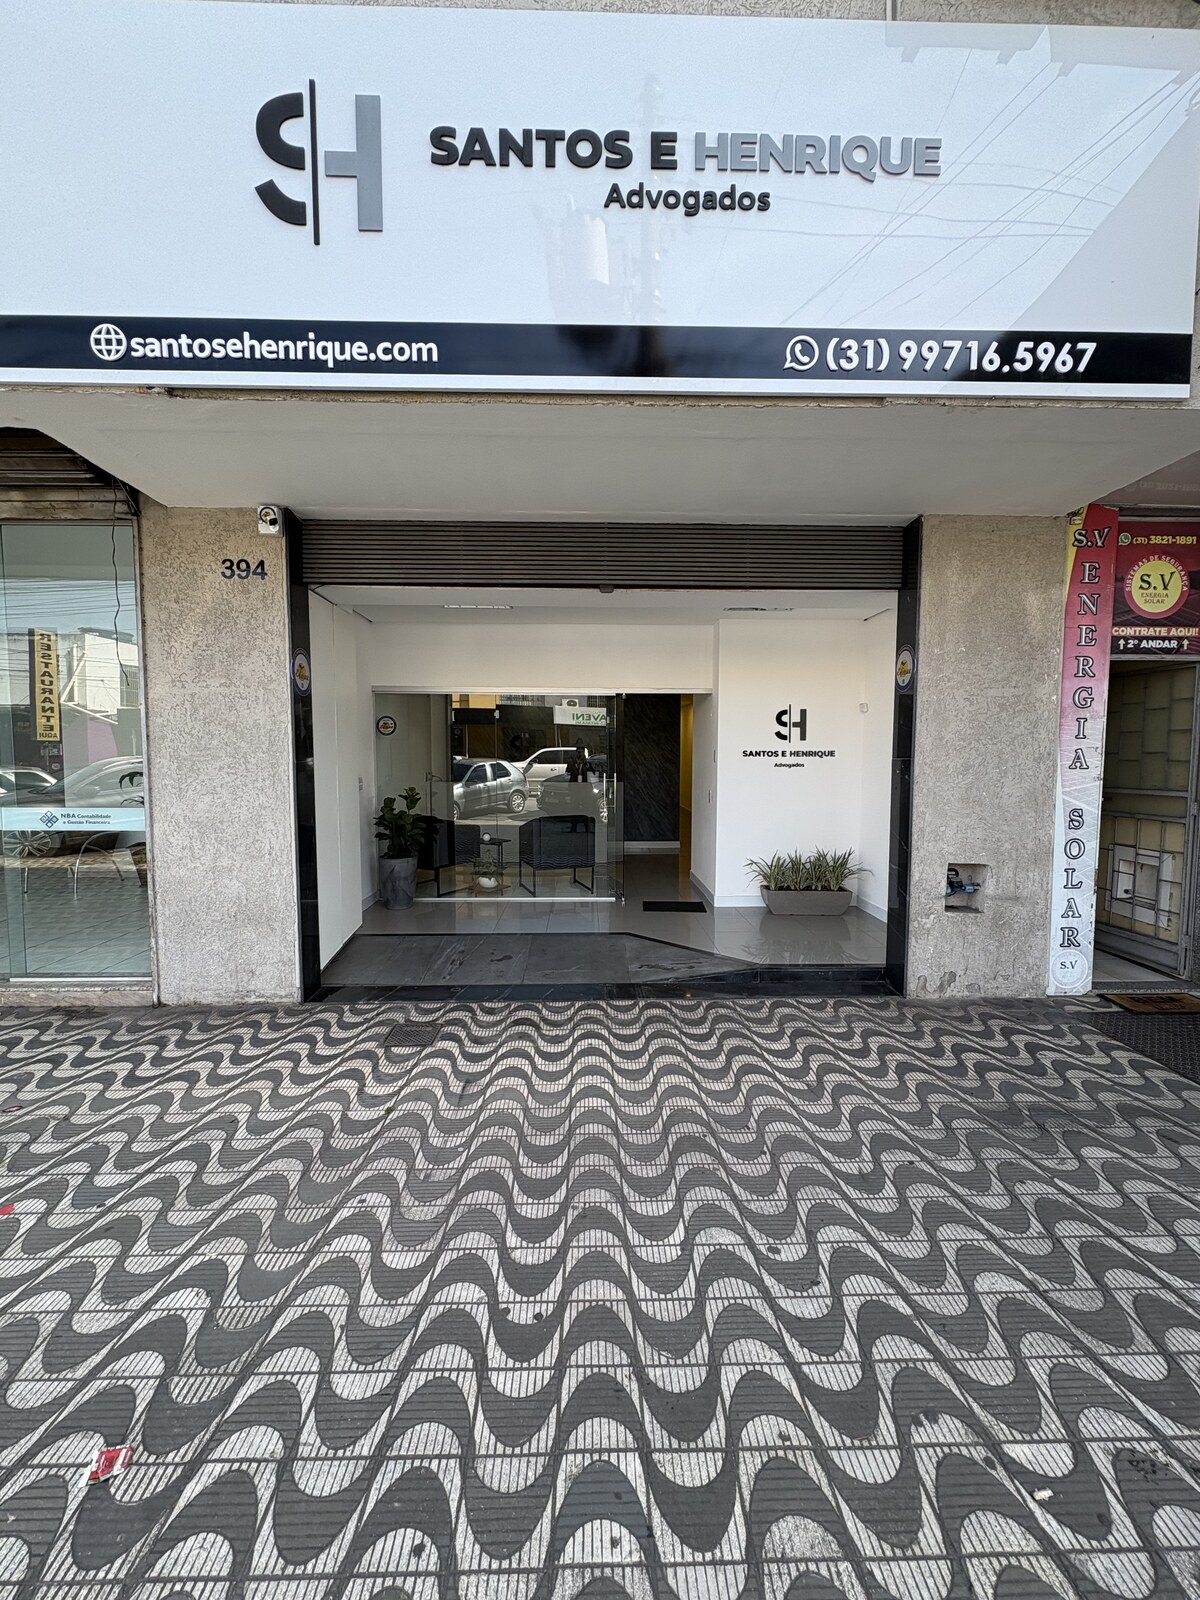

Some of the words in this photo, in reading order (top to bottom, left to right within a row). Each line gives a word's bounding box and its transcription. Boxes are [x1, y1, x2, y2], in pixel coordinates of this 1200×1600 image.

[429, 126, 634, 169] SANTOS
[650, 131, 678, 170] E
[694, 131, 943, 183] HENRIQUE
[604, 182, 771, 216] Advogados
[130, 332, 439, 368] santosehenrique.com
[826, 337, 889, 373] (31)
[898, 338, 1098, 375] 99716.5967
[1073, 527, 1111, 548] S.V
[1149, 535, 1197, 545] 3821-1891
[221, 558, 268, 581] 394
[1138, 571, 1177, 591] S.V
[1112, 627, 1168, 636] CONTRATE
[1169, 627, 1199, 636] AQUI!
[1140, 640, 1178, 648] ANDAR
[1069, 562, 1101, 769] ENERGIA
[789, 750, 836, 758] HENRIQUE
[1060, 808, 1085, 947] SOLAR
[1060, 960, 1078, 970] S.V
